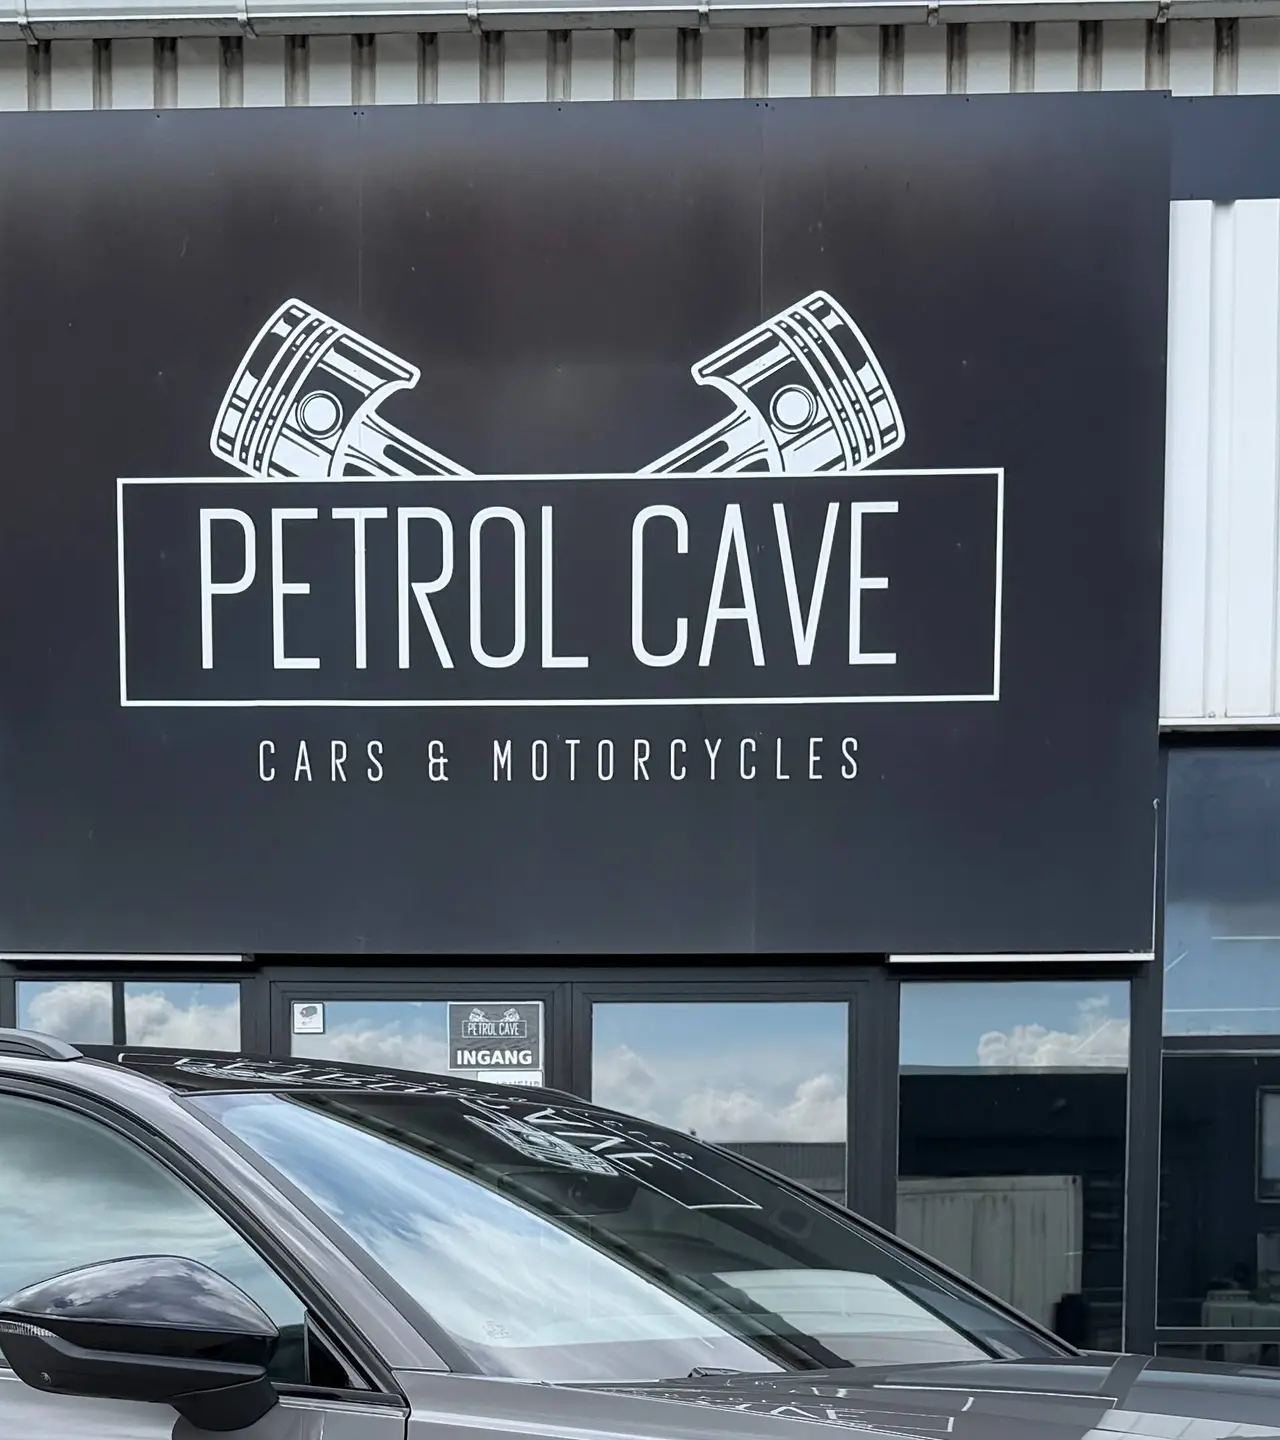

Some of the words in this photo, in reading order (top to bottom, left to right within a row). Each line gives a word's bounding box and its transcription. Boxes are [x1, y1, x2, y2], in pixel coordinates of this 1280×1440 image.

[199, 505, 589, 669] PETROL
[631, 501, 899, 667] CAVE
[258, 740, 384, 782] CARS
[428, 739, 449, 782] &
[493, 736, 859, 782] MOTORCYCLES
[467, 1022, 498, 1036] PETROL
[498, 1022, 520, 1036] CAVE
[457, 1050, 532, 1065] INGANG
